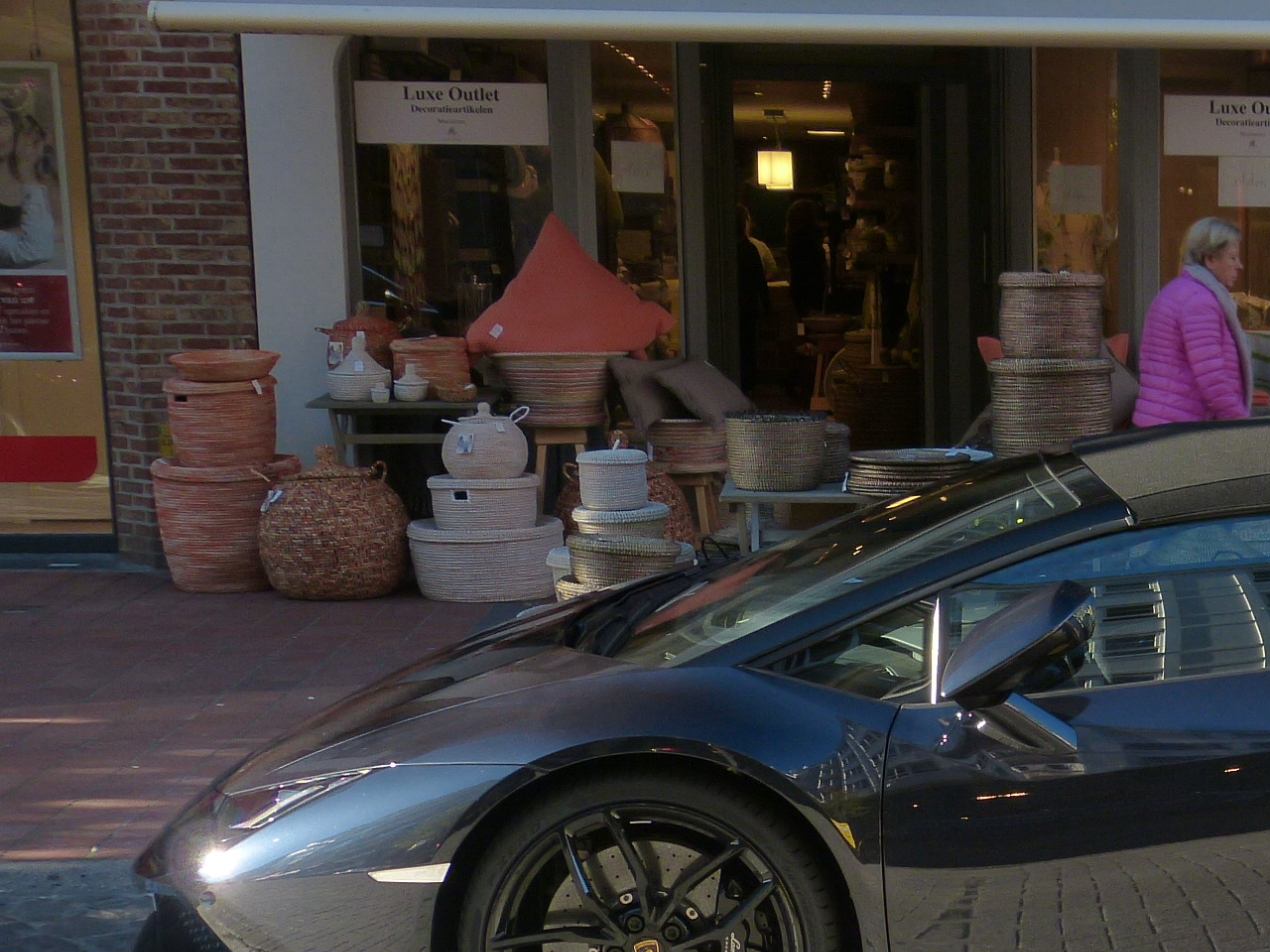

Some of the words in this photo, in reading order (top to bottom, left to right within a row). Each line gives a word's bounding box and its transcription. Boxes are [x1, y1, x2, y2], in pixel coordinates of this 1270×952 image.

[403, 85, 444, 101] Luxe
[449, 86, 500, 102] Outlet
[410, 104, 494, 114] Decoratieartikelen
[1209, 100, 1247, 115] Luxe
